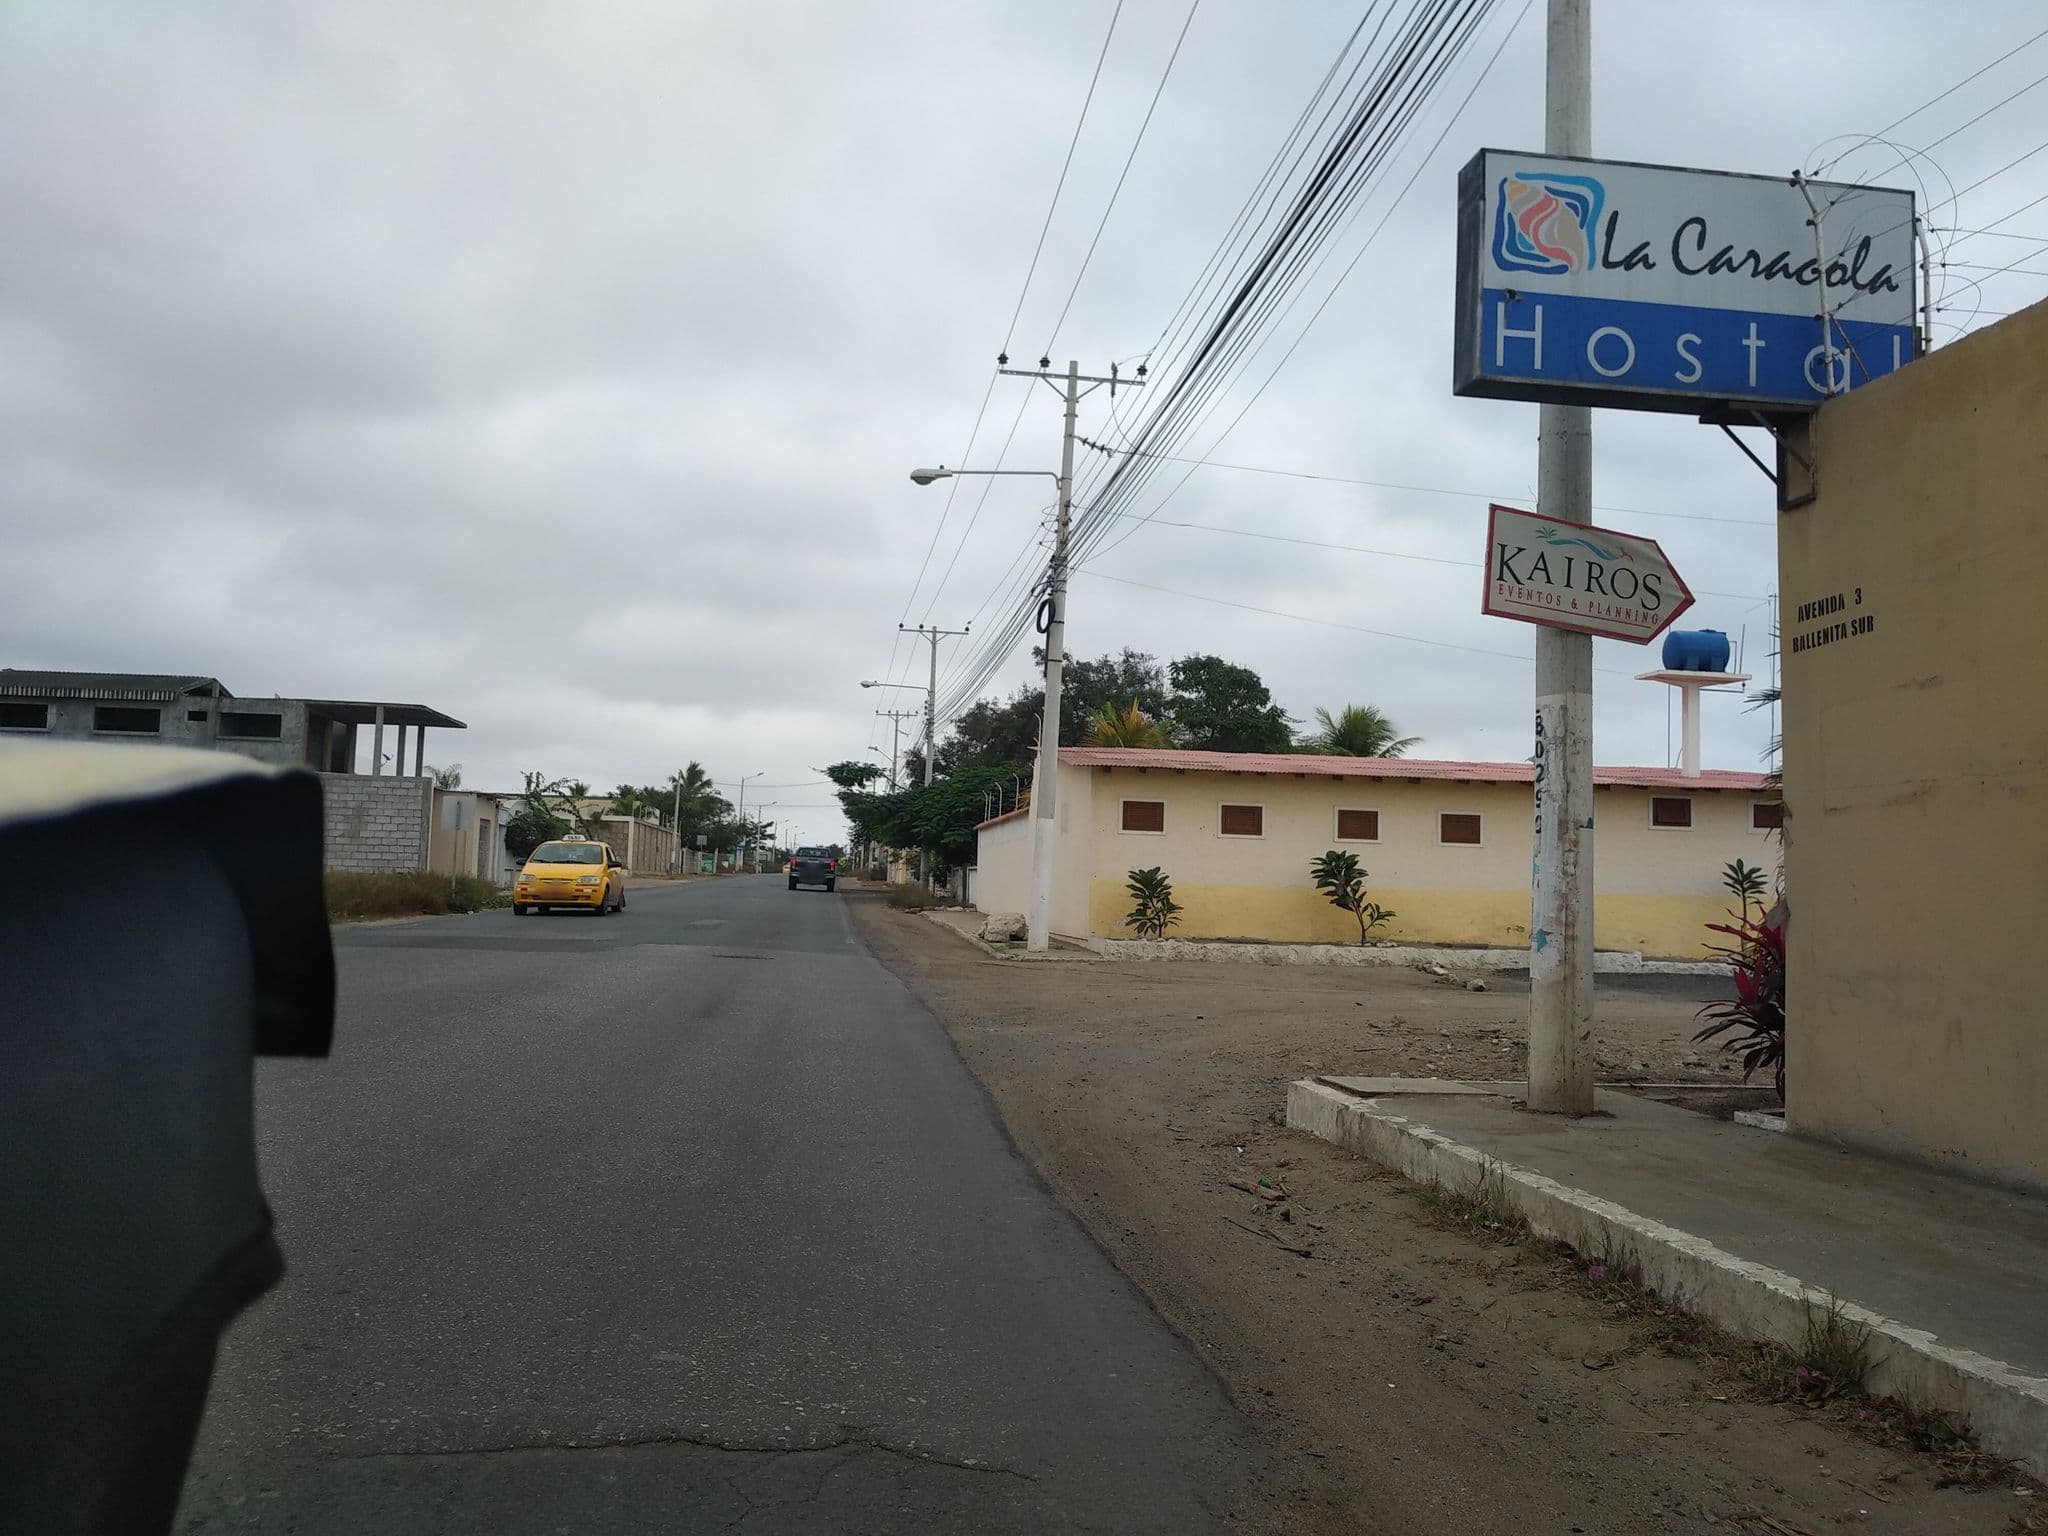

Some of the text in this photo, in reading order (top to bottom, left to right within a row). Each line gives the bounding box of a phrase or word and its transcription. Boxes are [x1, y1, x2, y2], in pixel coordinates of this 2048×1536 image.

[1600, 209, 1656, 272] La
[1496, 542, 1662, 611] KAIROS
[1498, 584, 1659, 625] EVENTOS & PLANNING
[1797, 587, 1862, 623] AVENIDA 3
[1792, 615, 1874, 653] BALLENITA SUR
